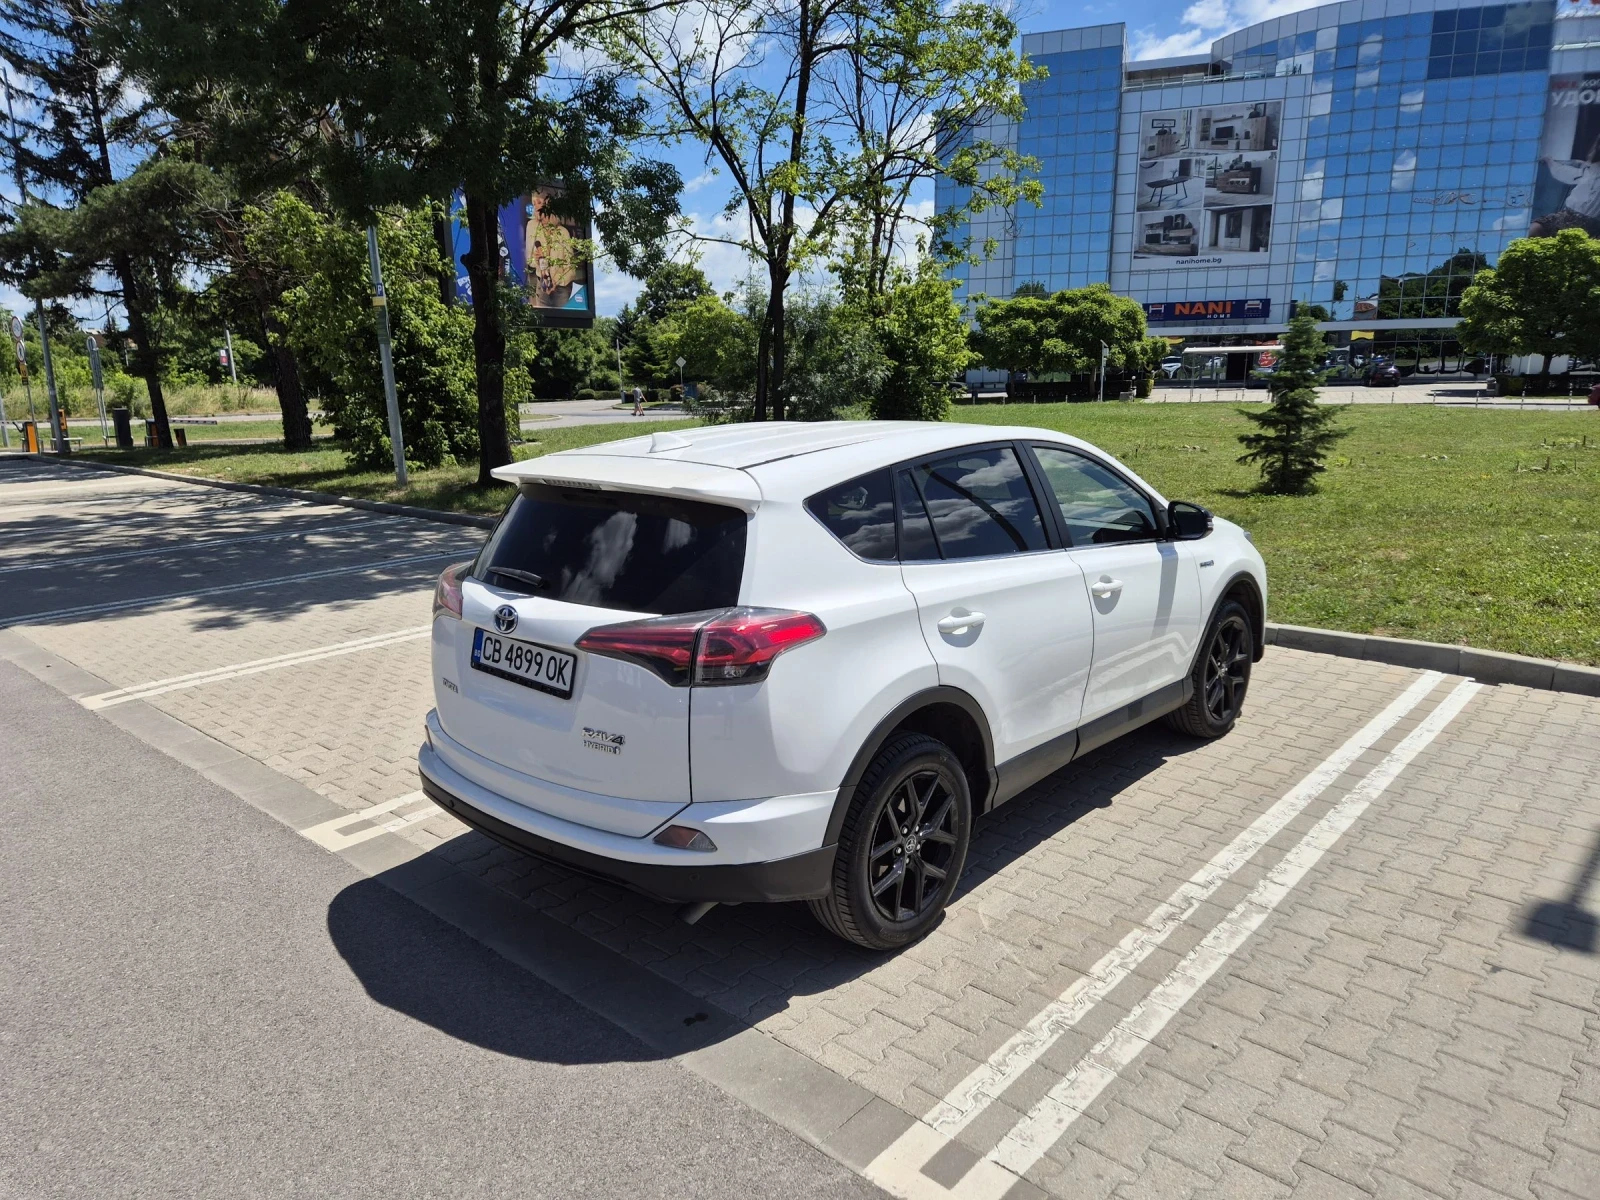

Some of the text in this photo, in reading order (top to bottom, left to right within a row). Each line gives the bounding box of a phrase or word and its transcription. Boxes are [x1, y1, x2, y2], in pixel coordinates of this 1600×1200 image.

[1175, 257, 1222, 265] nanihome.bg
[1174, 301, 1232, 315] NANI
[482, 636, 570, 686] CB 4899 OK
[581, 726, 626, 746] RAV4
